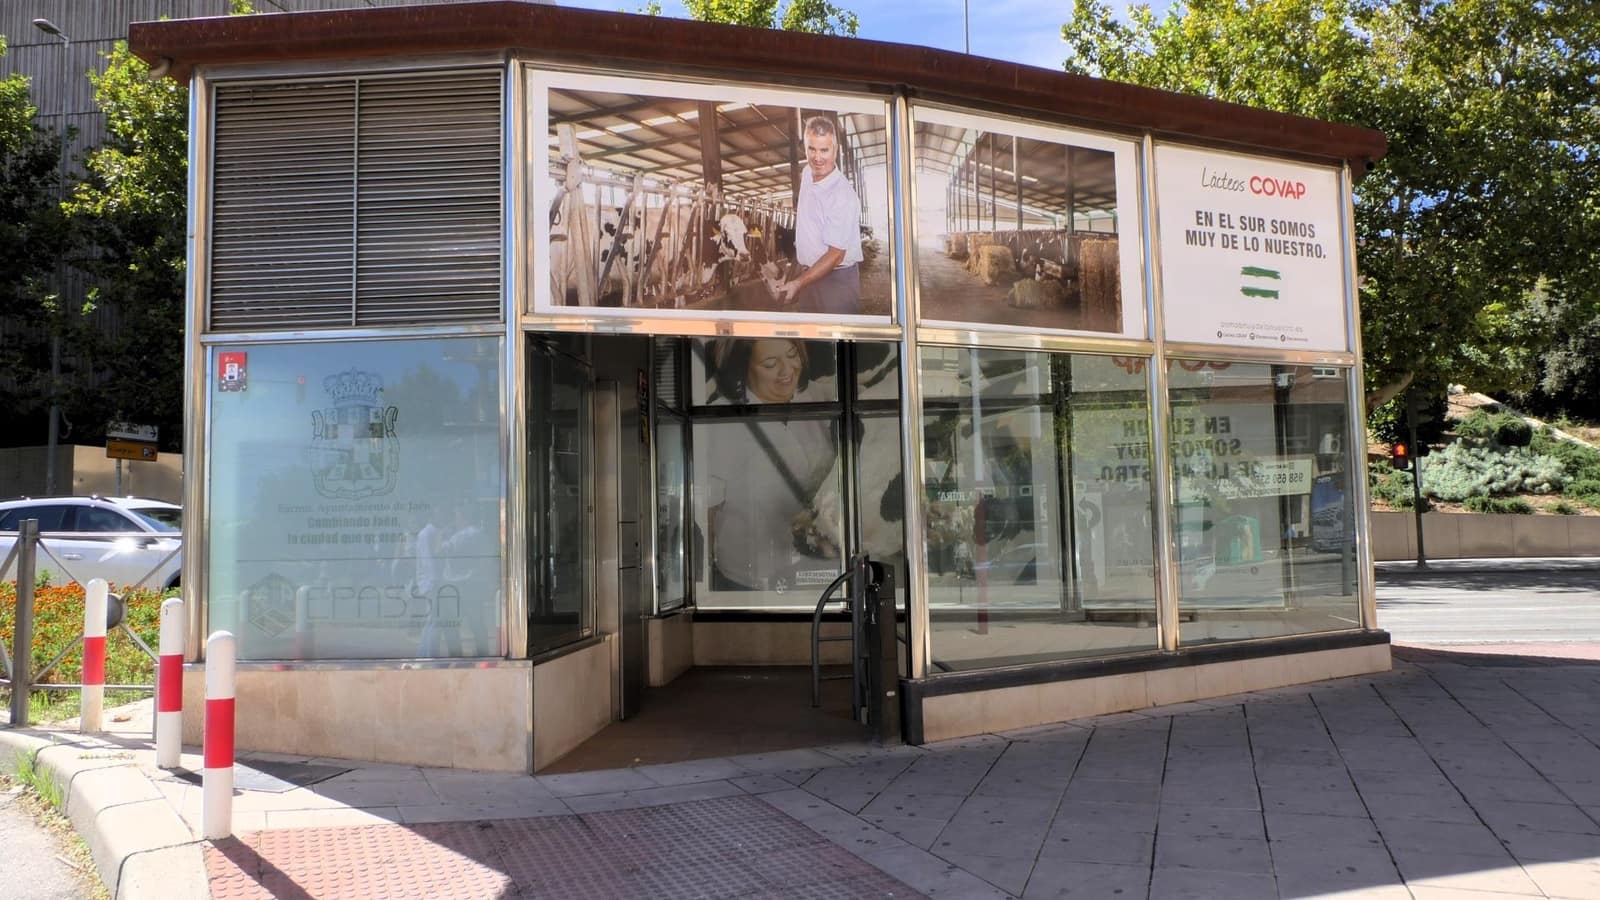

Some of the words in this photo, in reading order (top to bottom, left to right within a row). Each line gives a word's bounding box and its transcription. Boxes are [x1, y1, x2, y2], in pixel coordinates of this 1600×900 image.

[1201, 167, 1245, 192] Lácteos
[1250, 175, 1306, 200] COVAP
[1195, 210, 1213, 227] EN
[1219, 213, 1234, 229] EL
[1240, 215, 1266, 233] SUR
[1271, 219, 1316, 238] SOMOS
[1185, 229, 1216, 248] MUY
[1221, 233, 1239, 250] DE
[1244, 236, 1259, 253] LO
[1265, 238, 1327, 259] NUESTRO.
